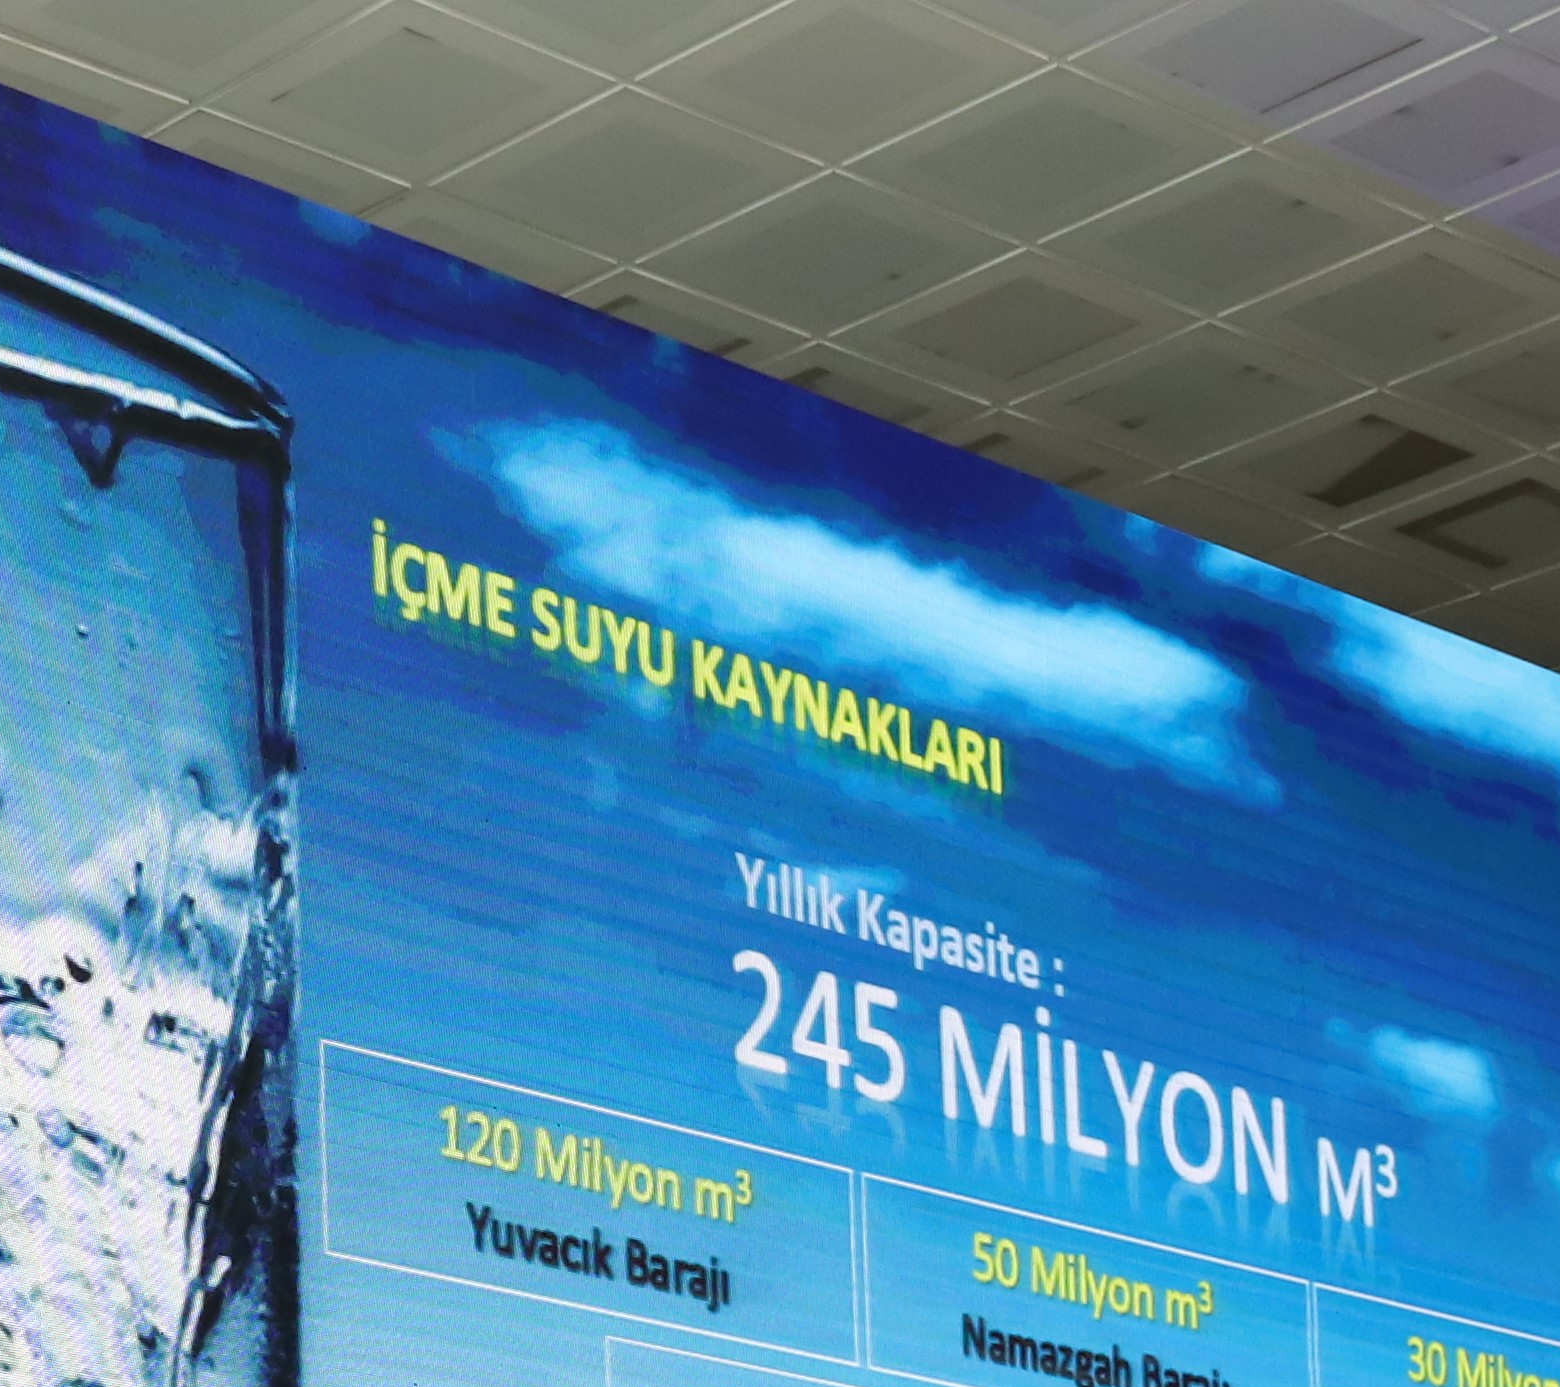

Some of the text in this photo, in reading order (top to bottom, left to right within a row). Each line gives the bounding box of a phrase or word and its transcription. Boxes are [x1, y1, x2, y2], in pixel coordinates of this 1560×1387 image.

[372, 517, 1003, 795] İÇME SUYU KAYNAKLARI
[735, 851, 1040, 989] Yıllık Kapasite
[733, 949, 906, 1102] 245
[939, 1004, 1289, 1204] MİLYON
[439, 1105, 521, 1173] 120
[535, 1127, 682, 1210] Milyon
[466, 1200, 731, 1313] Yuvacık Barajı
[972, 1232, 1020, 1288] 50
[1032, 1246, 1155, 1320] Milyon
[1407, 1336, 1447, 1387] 30
